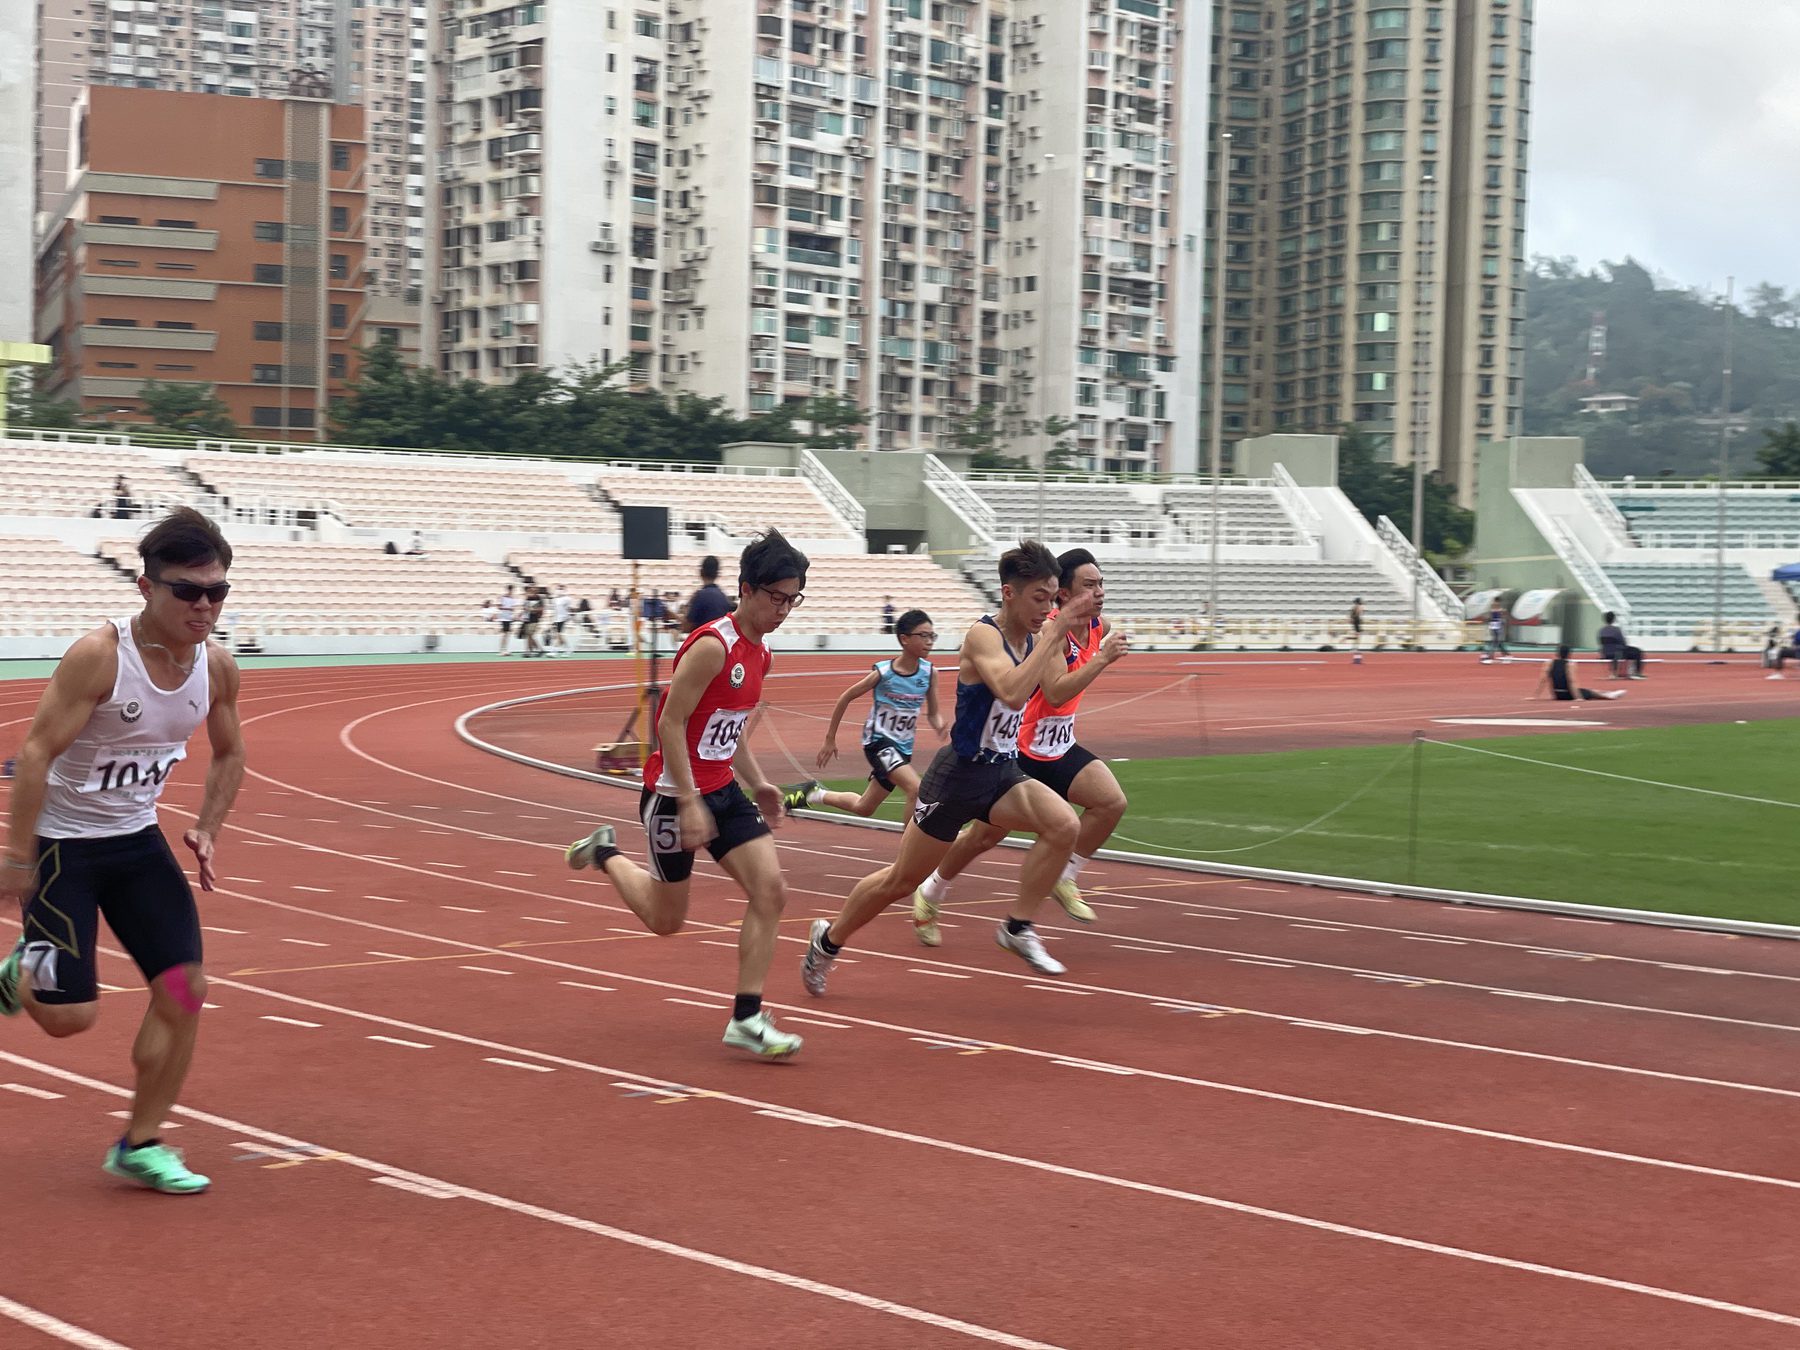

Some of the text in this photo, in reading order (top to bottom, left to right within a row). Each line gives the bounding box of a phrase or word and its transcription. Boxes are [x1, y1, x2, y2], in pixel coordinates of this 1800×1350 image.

[709, 716, 748, 746] 104
[878, 711, 917, 732] 1150
[656, 818, 677, 850] 5
[29, 945, 51, 986] 7
